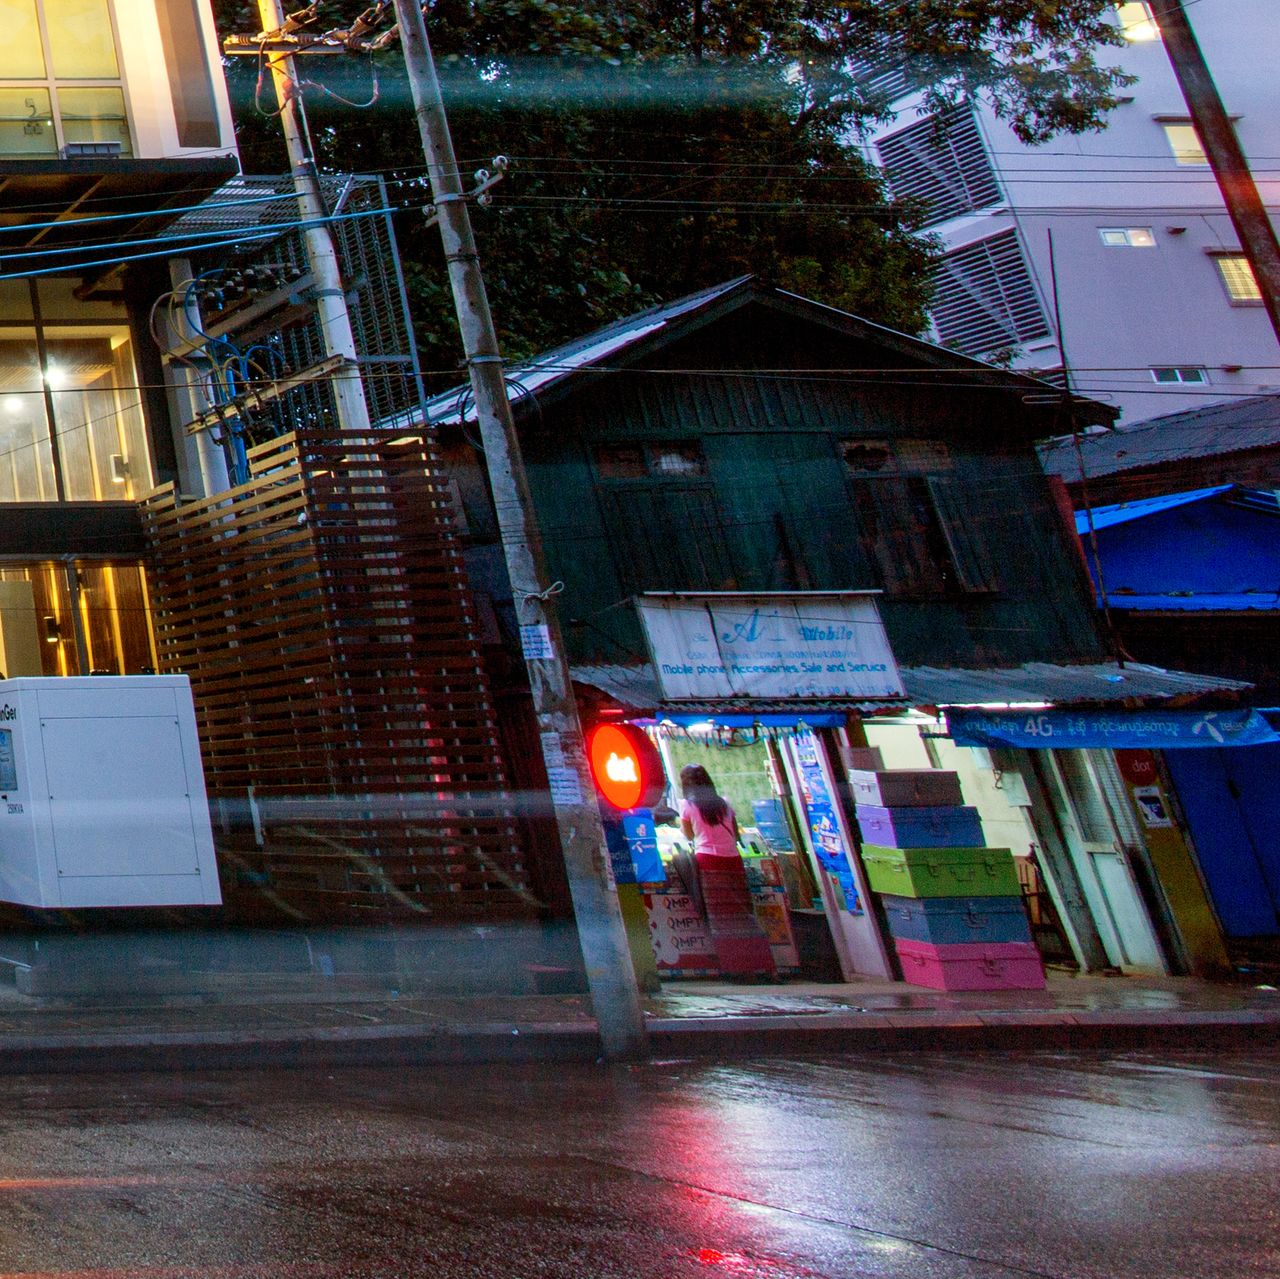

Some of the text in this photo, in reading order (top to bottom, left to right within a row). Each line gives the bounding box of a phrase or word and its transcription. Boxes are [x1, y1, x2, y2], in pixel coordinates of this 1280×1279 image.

[662, 663, 693, 675] Mobile
[826, 661, 846, 673] and
[847, 660, 888, 673] Service
[1024, 715, 1054, 737] 4G
